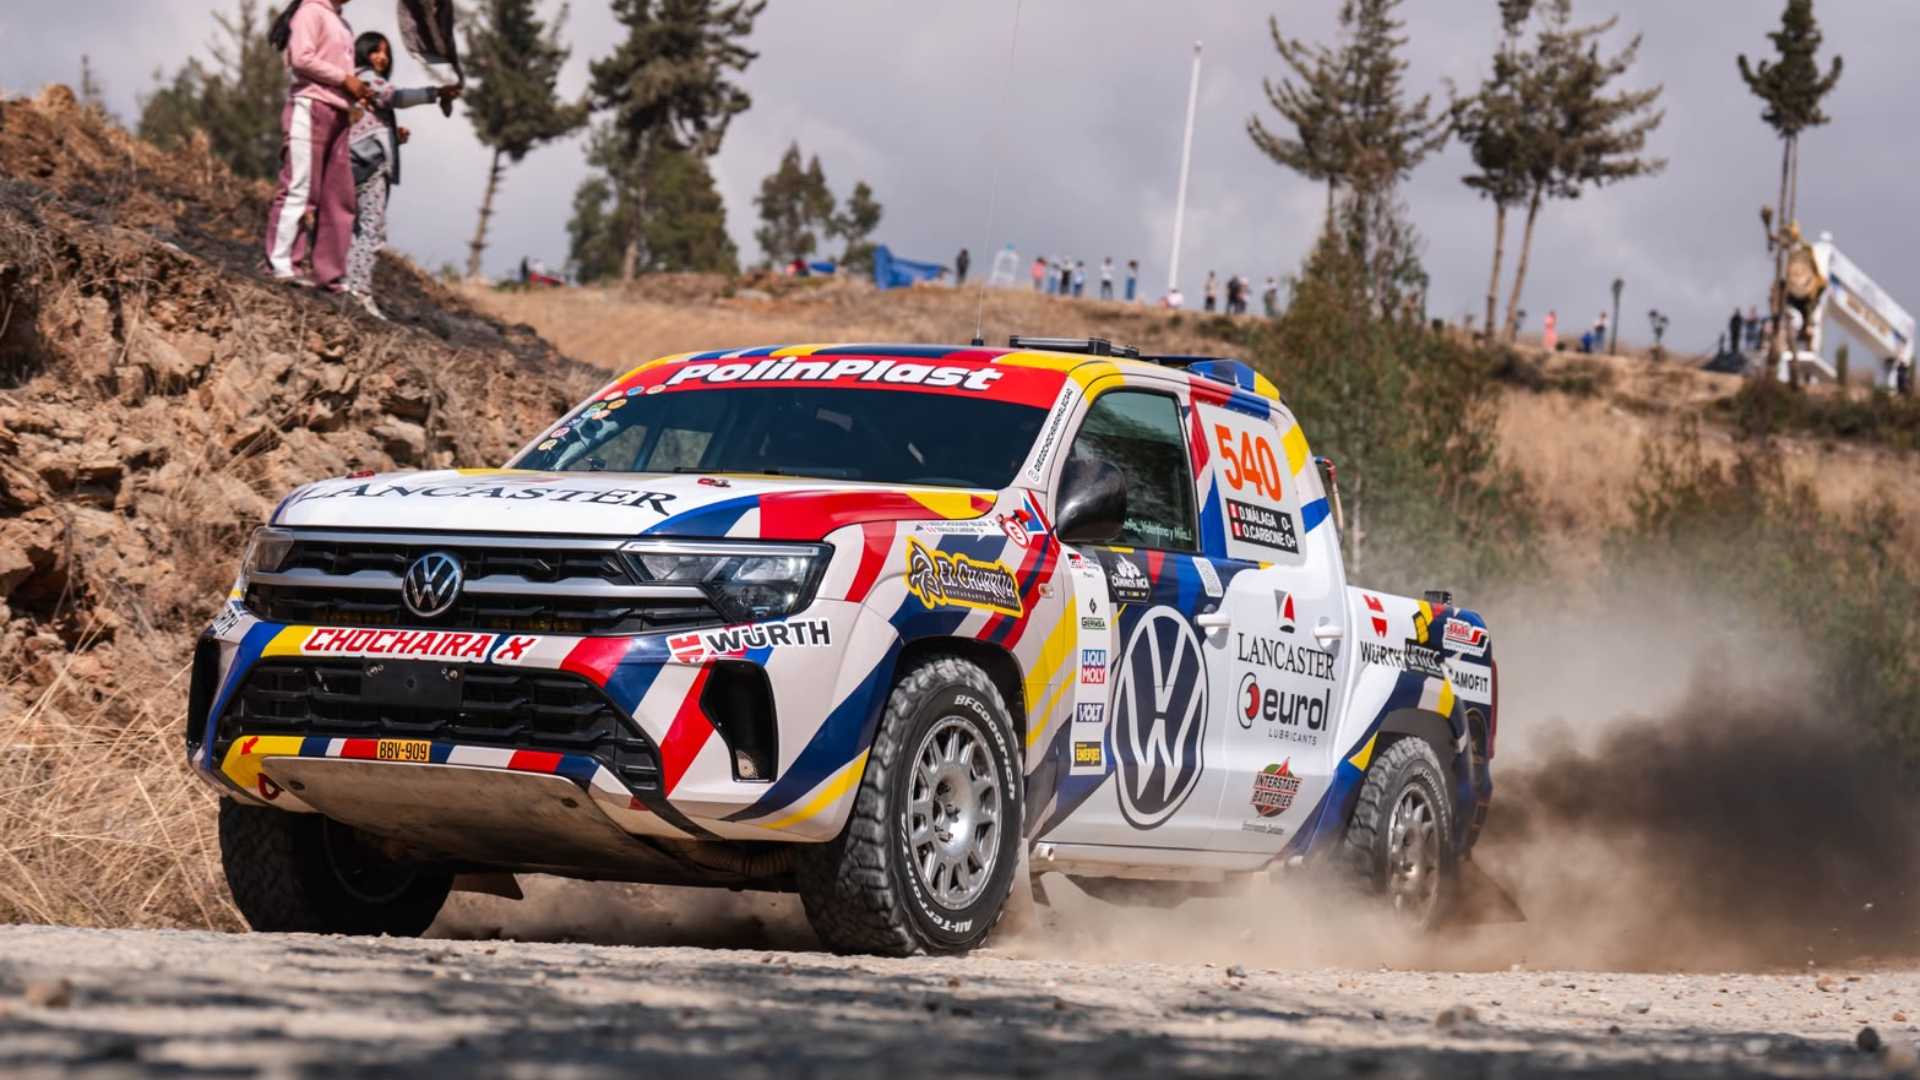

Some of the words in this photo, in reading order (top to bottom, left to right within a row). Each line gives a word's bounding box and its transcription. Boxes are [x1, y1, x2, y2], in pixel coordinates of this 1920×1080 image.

[664, 357, 1003, 391] PolinPlast
[1215, 424, 1282, 501] 540
[293, 483, 677, 516] LANCASTER
[304, 628, 493, 657] CHOCHAIRA
[495, 635, 537, 660] X
[706, 621, 830, 652] WÜRTH
[1083, 650, 1105, 666] LIQUI
[1238, 632, 1335, 681] LANCASTER
[1360, 640, 1406, 669] WÜRTH
[1082, 667, 1104, 683] MOLY
[1078, 703, 1102, 721] VOLT
[1262, 688, 1330, 731] eurol
[380, 742, 427, 760] BBV-909
[954, 694, 1015, 800] BFGoodrich
[1268, 728, 1317, 746] LUBRICANTS
[1256, 773, 1300, 793] INTERSTATE
[1253, 790, 1292, 808] BATTERIES
